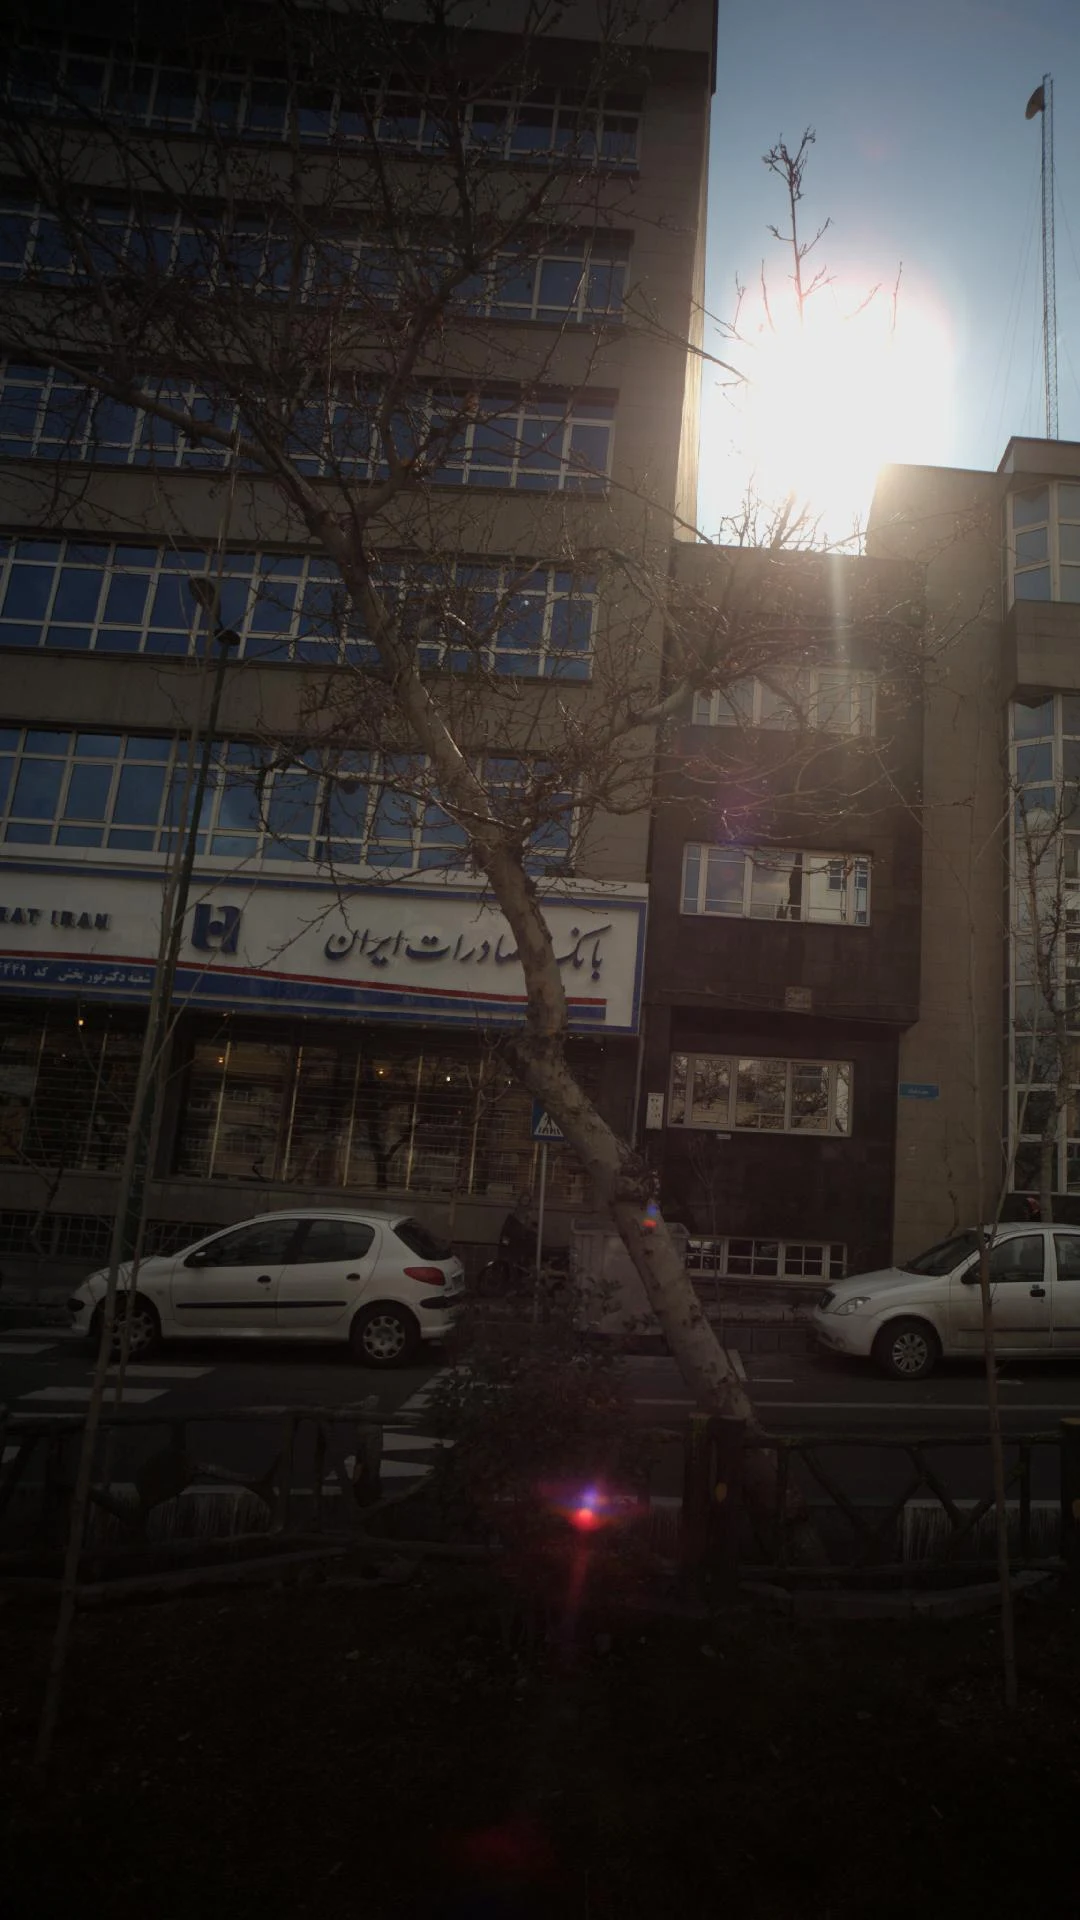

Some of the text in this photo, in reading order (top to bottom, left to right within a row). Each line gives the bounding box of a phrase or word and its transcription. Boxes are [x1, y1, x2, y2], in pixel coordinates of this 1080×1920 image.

[51, 910, 109, 930] IRAN
[325, 929, 403, 967] ایران
[555, 924, 612, 981] بانک
